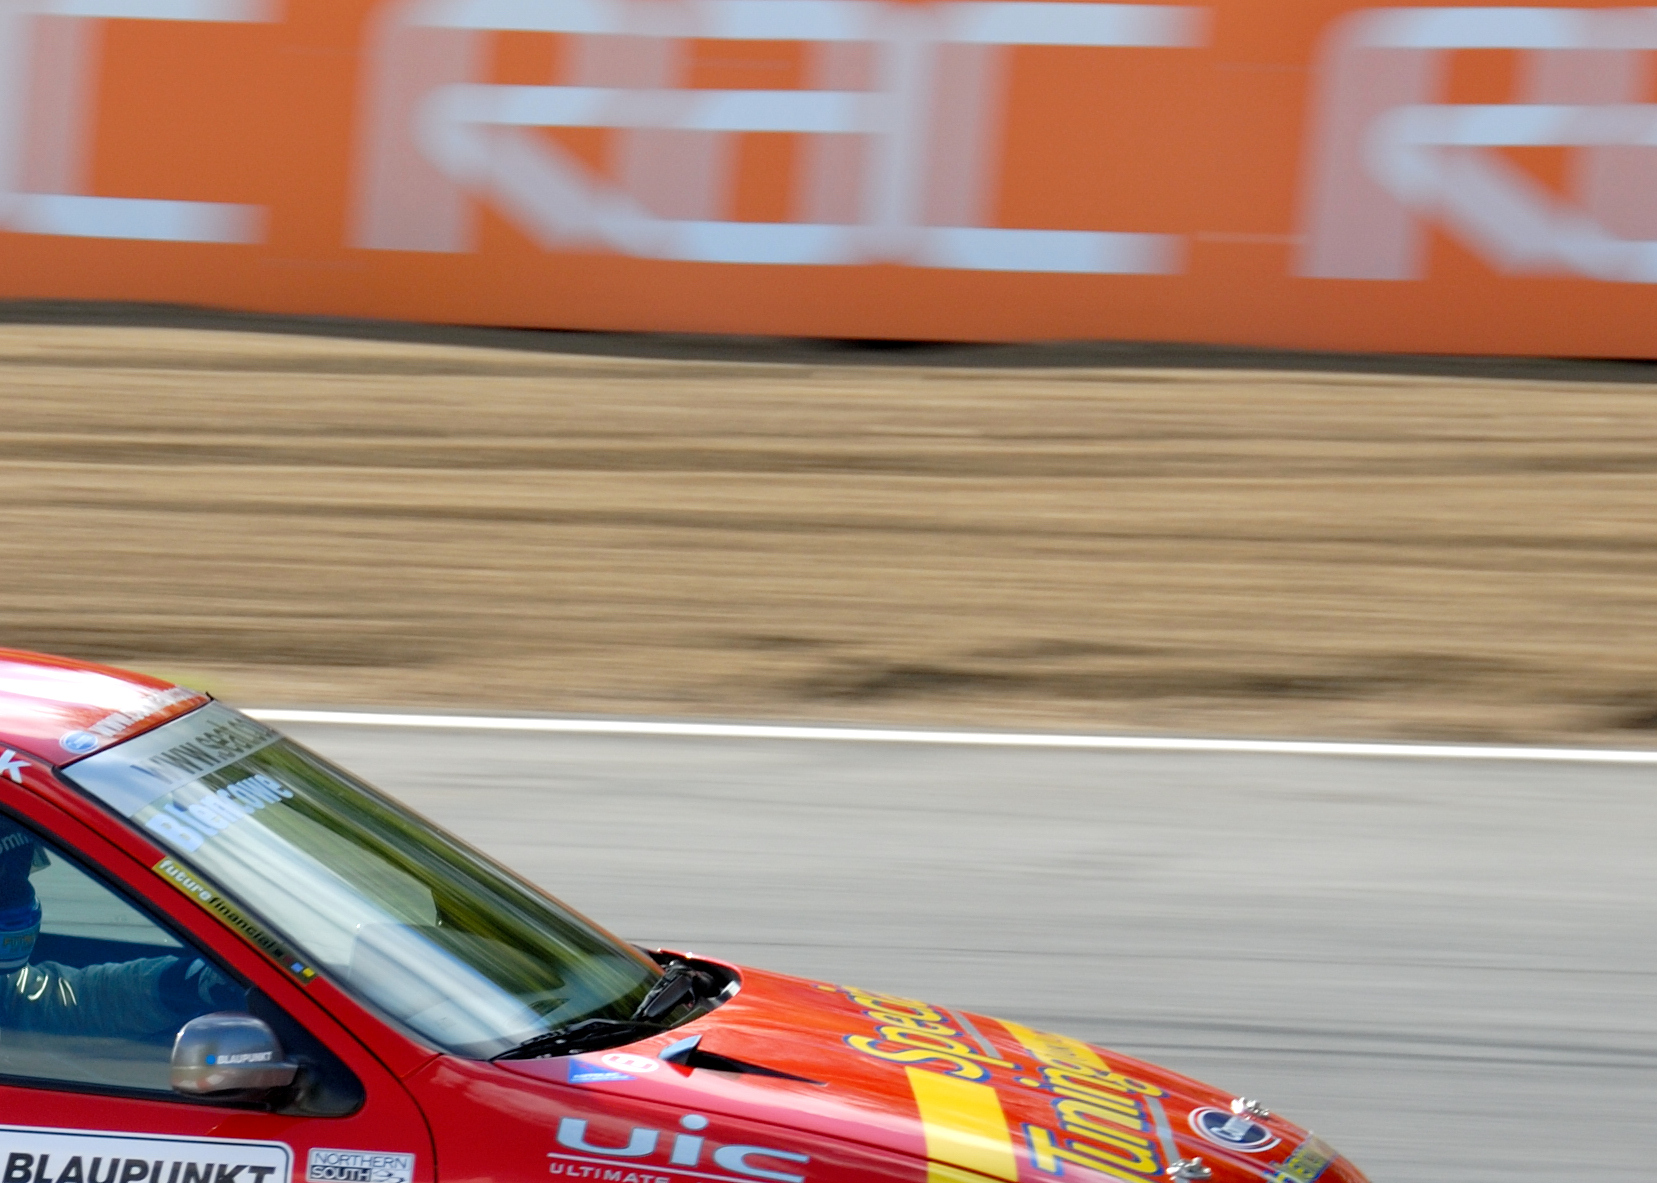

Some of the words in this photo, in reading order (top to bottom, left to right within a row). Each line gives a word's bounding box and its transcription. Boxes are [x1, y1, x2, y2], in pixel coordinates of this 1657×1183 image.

[217, 1050, 274, 1065] BLAUPUNKT
[314, 1152, 407, 1169] NORTHERN
[312, 1166, 370, 1181] SOUTH
